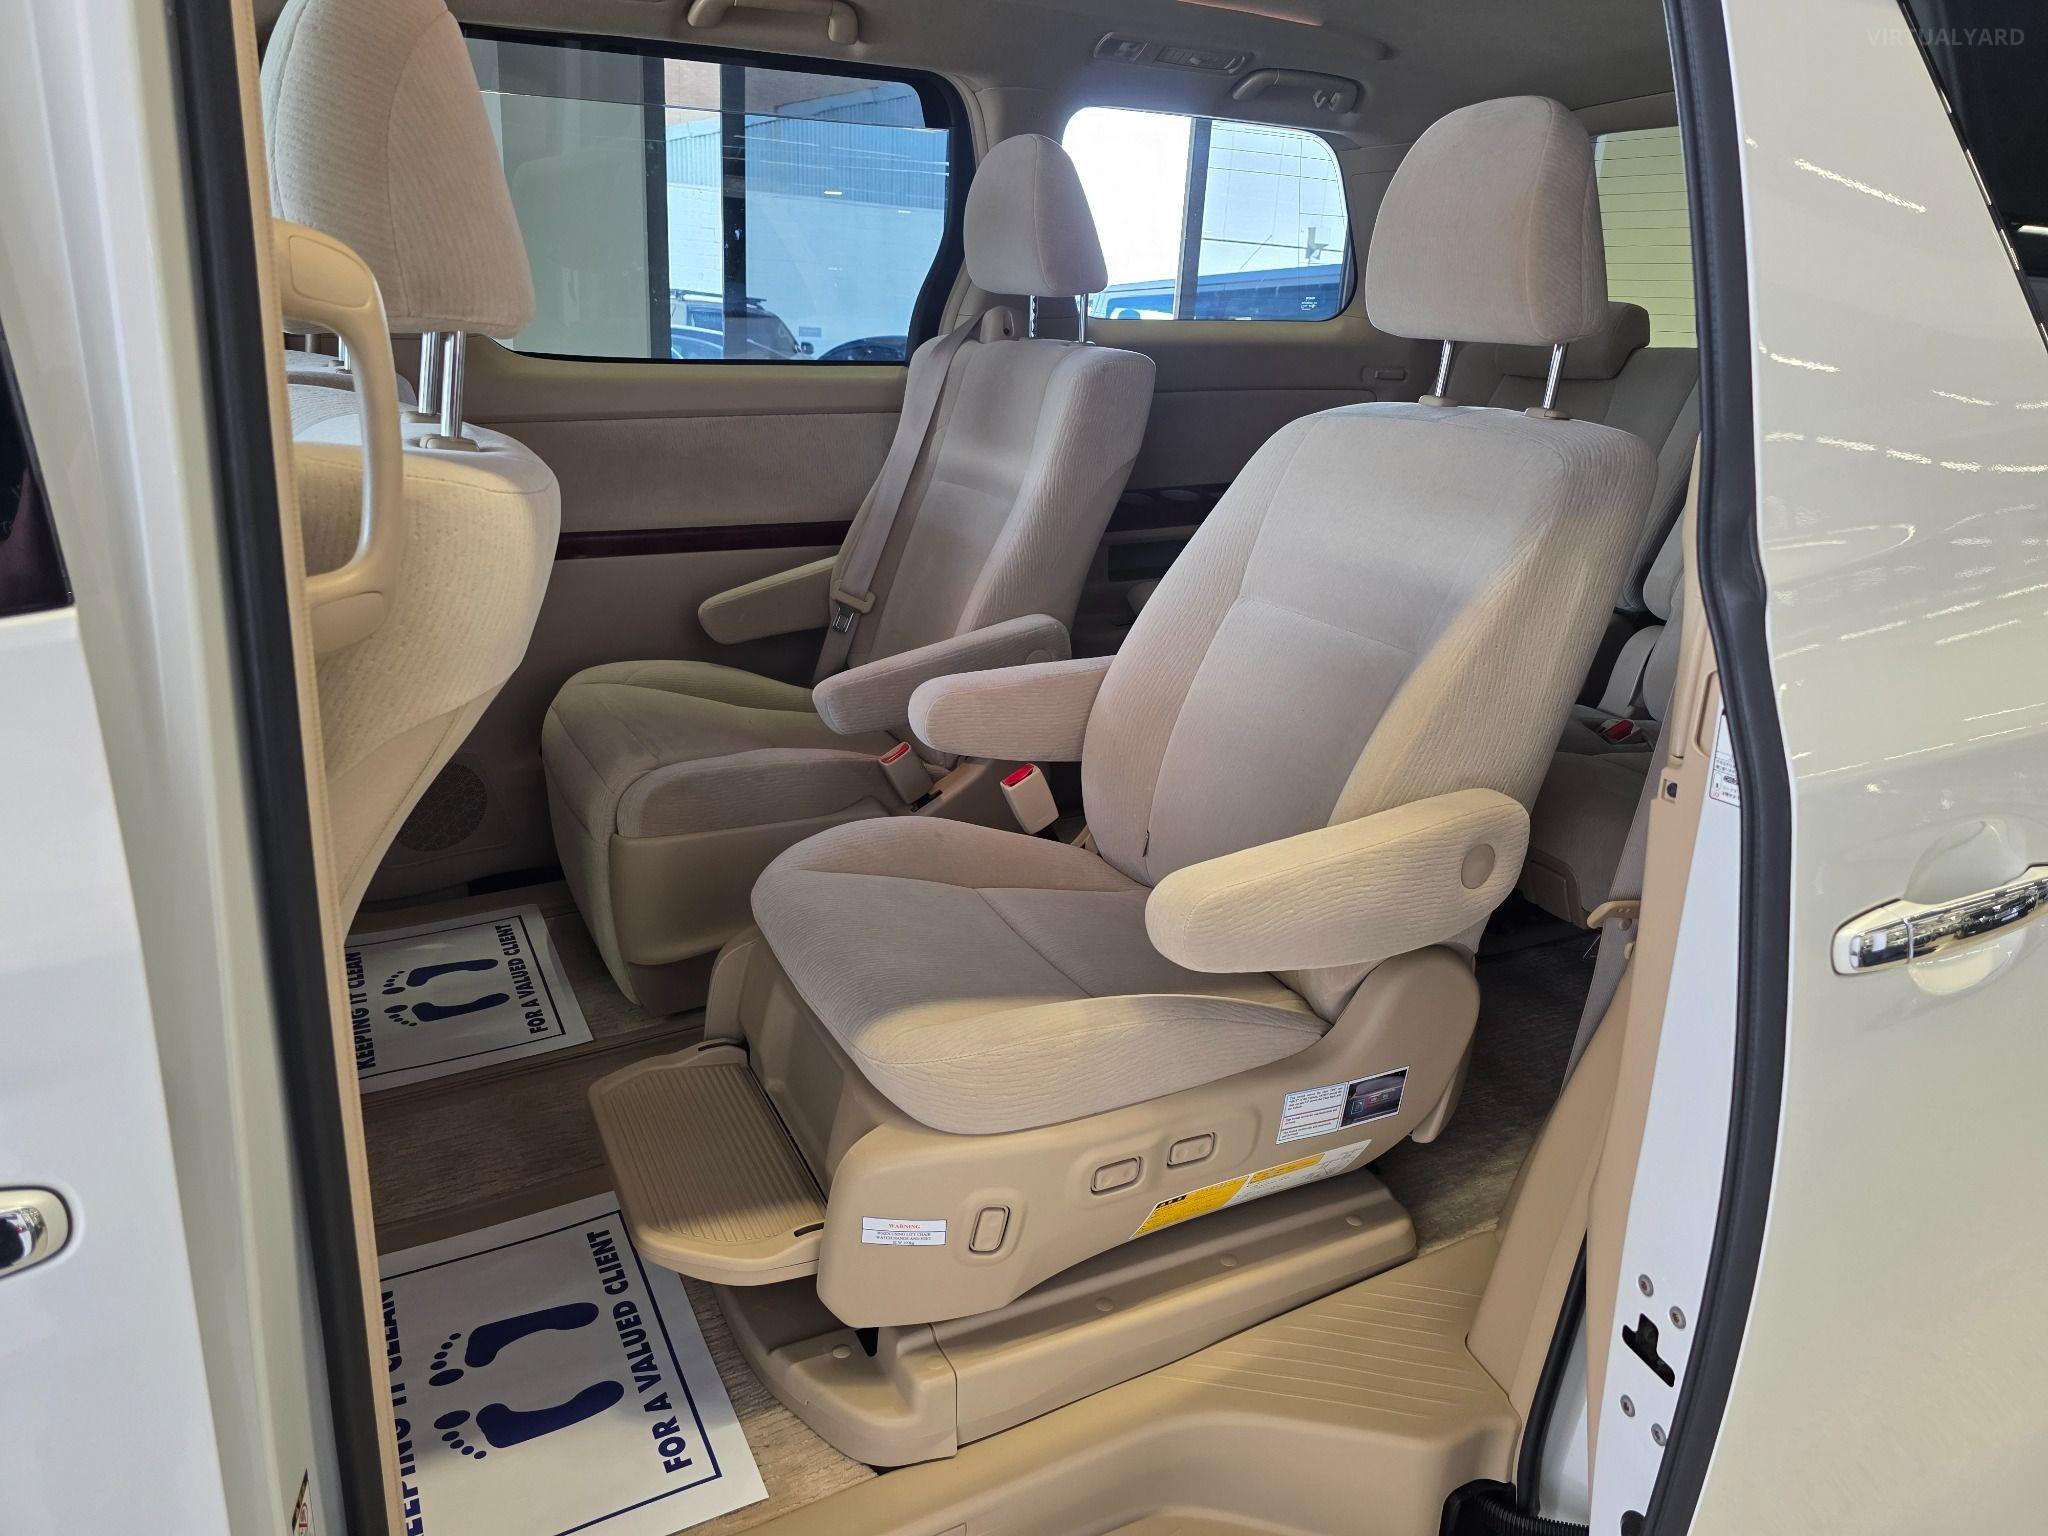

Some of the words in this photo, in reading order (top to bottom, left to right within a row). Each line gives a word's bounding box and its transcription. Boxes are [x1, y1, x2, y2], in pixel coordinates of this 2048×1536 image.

[495, 924, 521, 956] CLIENT
[345, 952, 365, 989] CLEAN
[507, 957, 535, 1000] VALUED
[349, 993, 368, 1005] IT
[521, 998, 539, 1008] A
[351, 1007, 376, 1071] KEEPING
[524, 1009, 549, 1035] FOR
[586, 1229, 629, 1296] CLIENT
[612, 1300, 662, 1394] VALUED
[642, 1391, 673, 1413] A
[651, 1415, 693, 1474] FOR
[394, 1418, 425, 1536] EEPING
